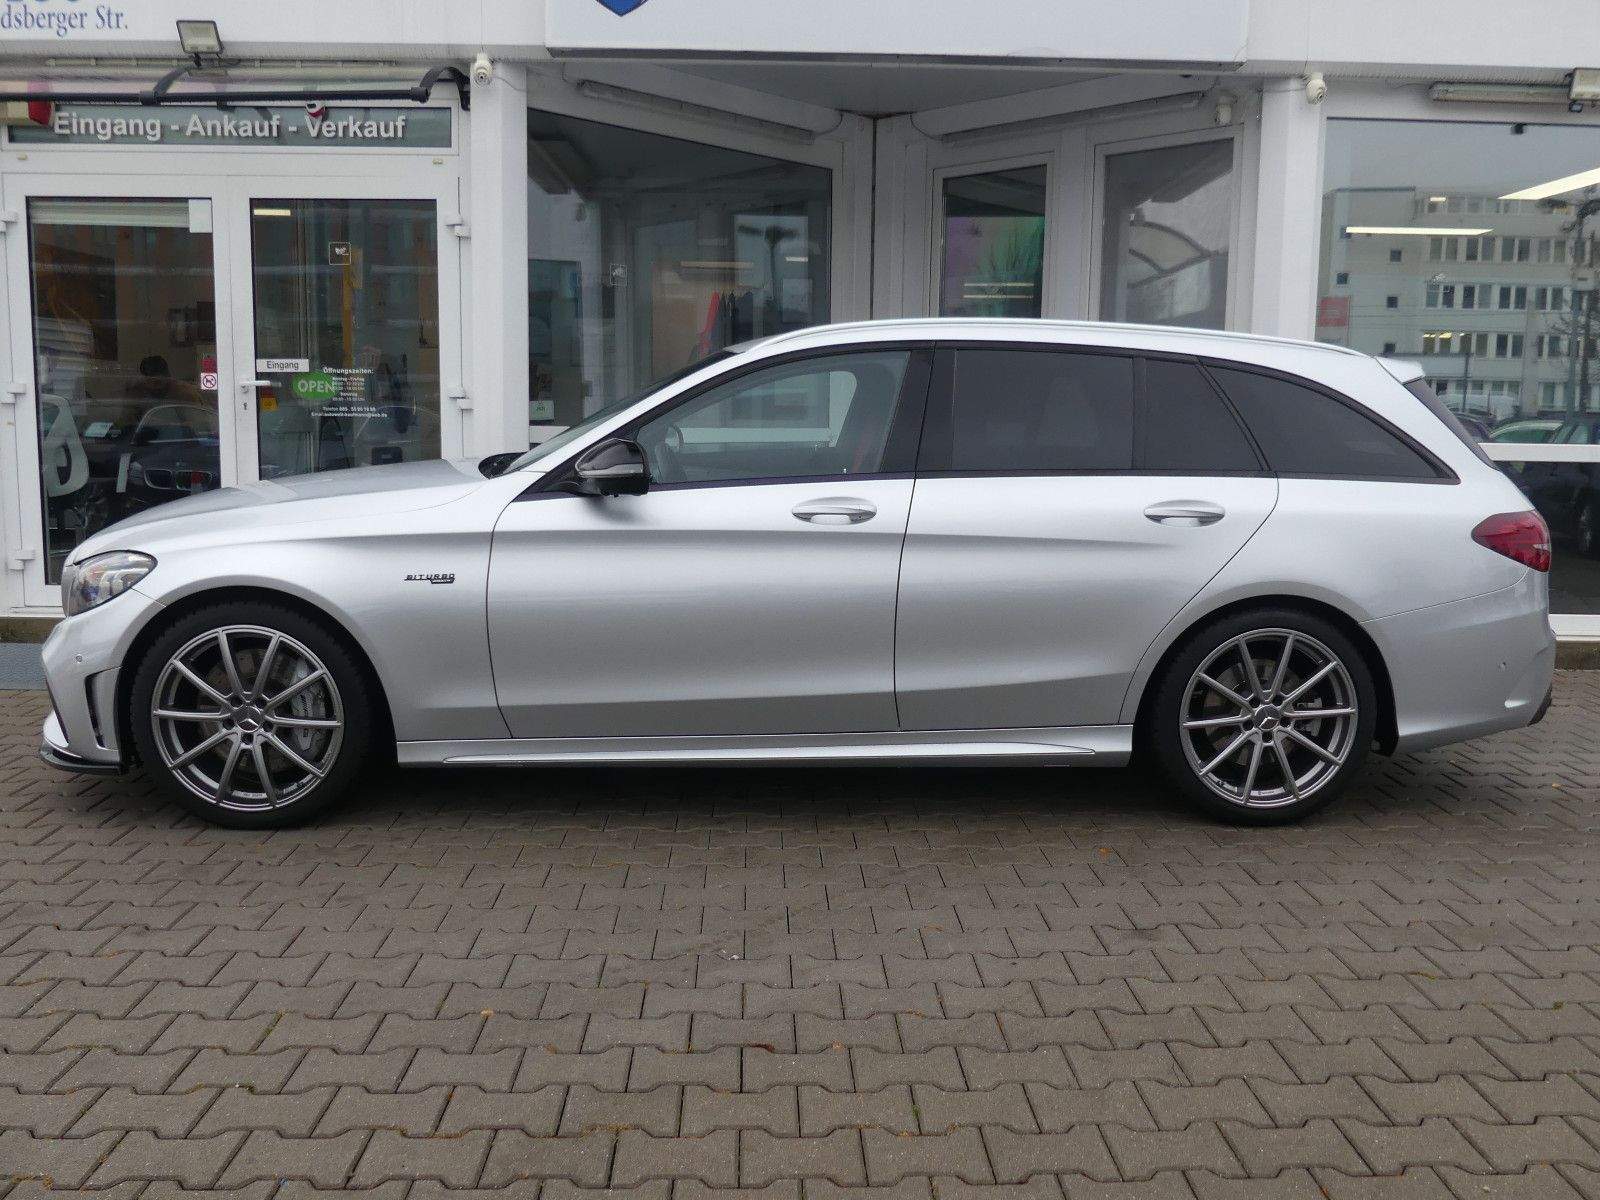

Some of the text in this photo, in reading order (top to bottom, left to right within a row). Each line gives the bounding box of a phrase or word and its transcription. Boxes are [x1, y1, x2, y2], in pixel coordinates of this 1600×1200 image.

[95, 5, 128, 29] Str.
[54, 112, 161, 141] Eingang
[185, 114, 281, 137] Ankauf
[304, 114, 407, 138] Verkauf
[266, 360, 299, 370] Eingang
[298, 381, 335, 392] OPEN
[404, 573, 455, 582] BITURBO
